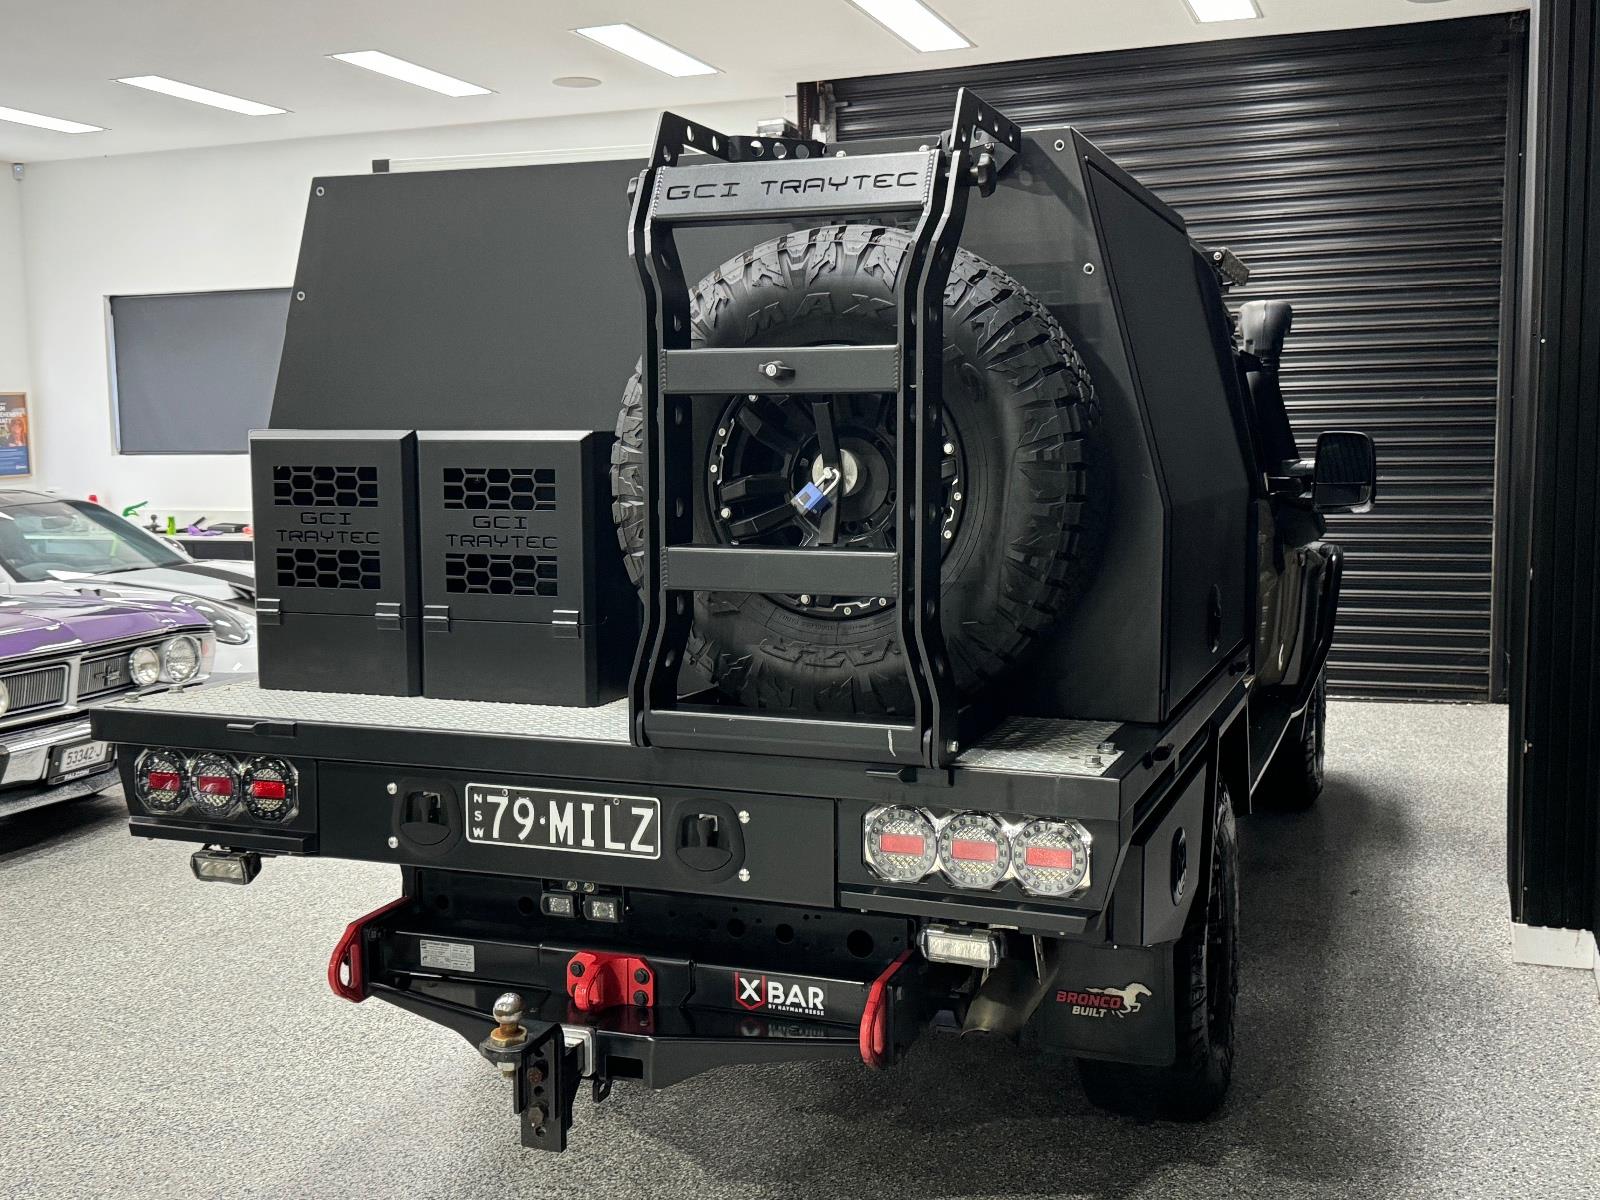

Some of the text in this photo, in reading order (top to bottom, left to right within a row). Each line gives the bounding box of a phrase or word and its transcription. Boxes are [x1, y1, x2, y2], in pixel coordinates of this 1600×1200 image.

[667, 172, 919, 200] GCI TRAYTEC
[301, 512, 352, 525] GCI
[473, 516, 528, 529] GCI
[276, 529, 380, 544] TRAYTEC
[445, 534, 559, 549] TRAYTEC
[1056, 991, 1121, 1009] BRONCO
[1072, 1006, 1108, 1018] BUILT
